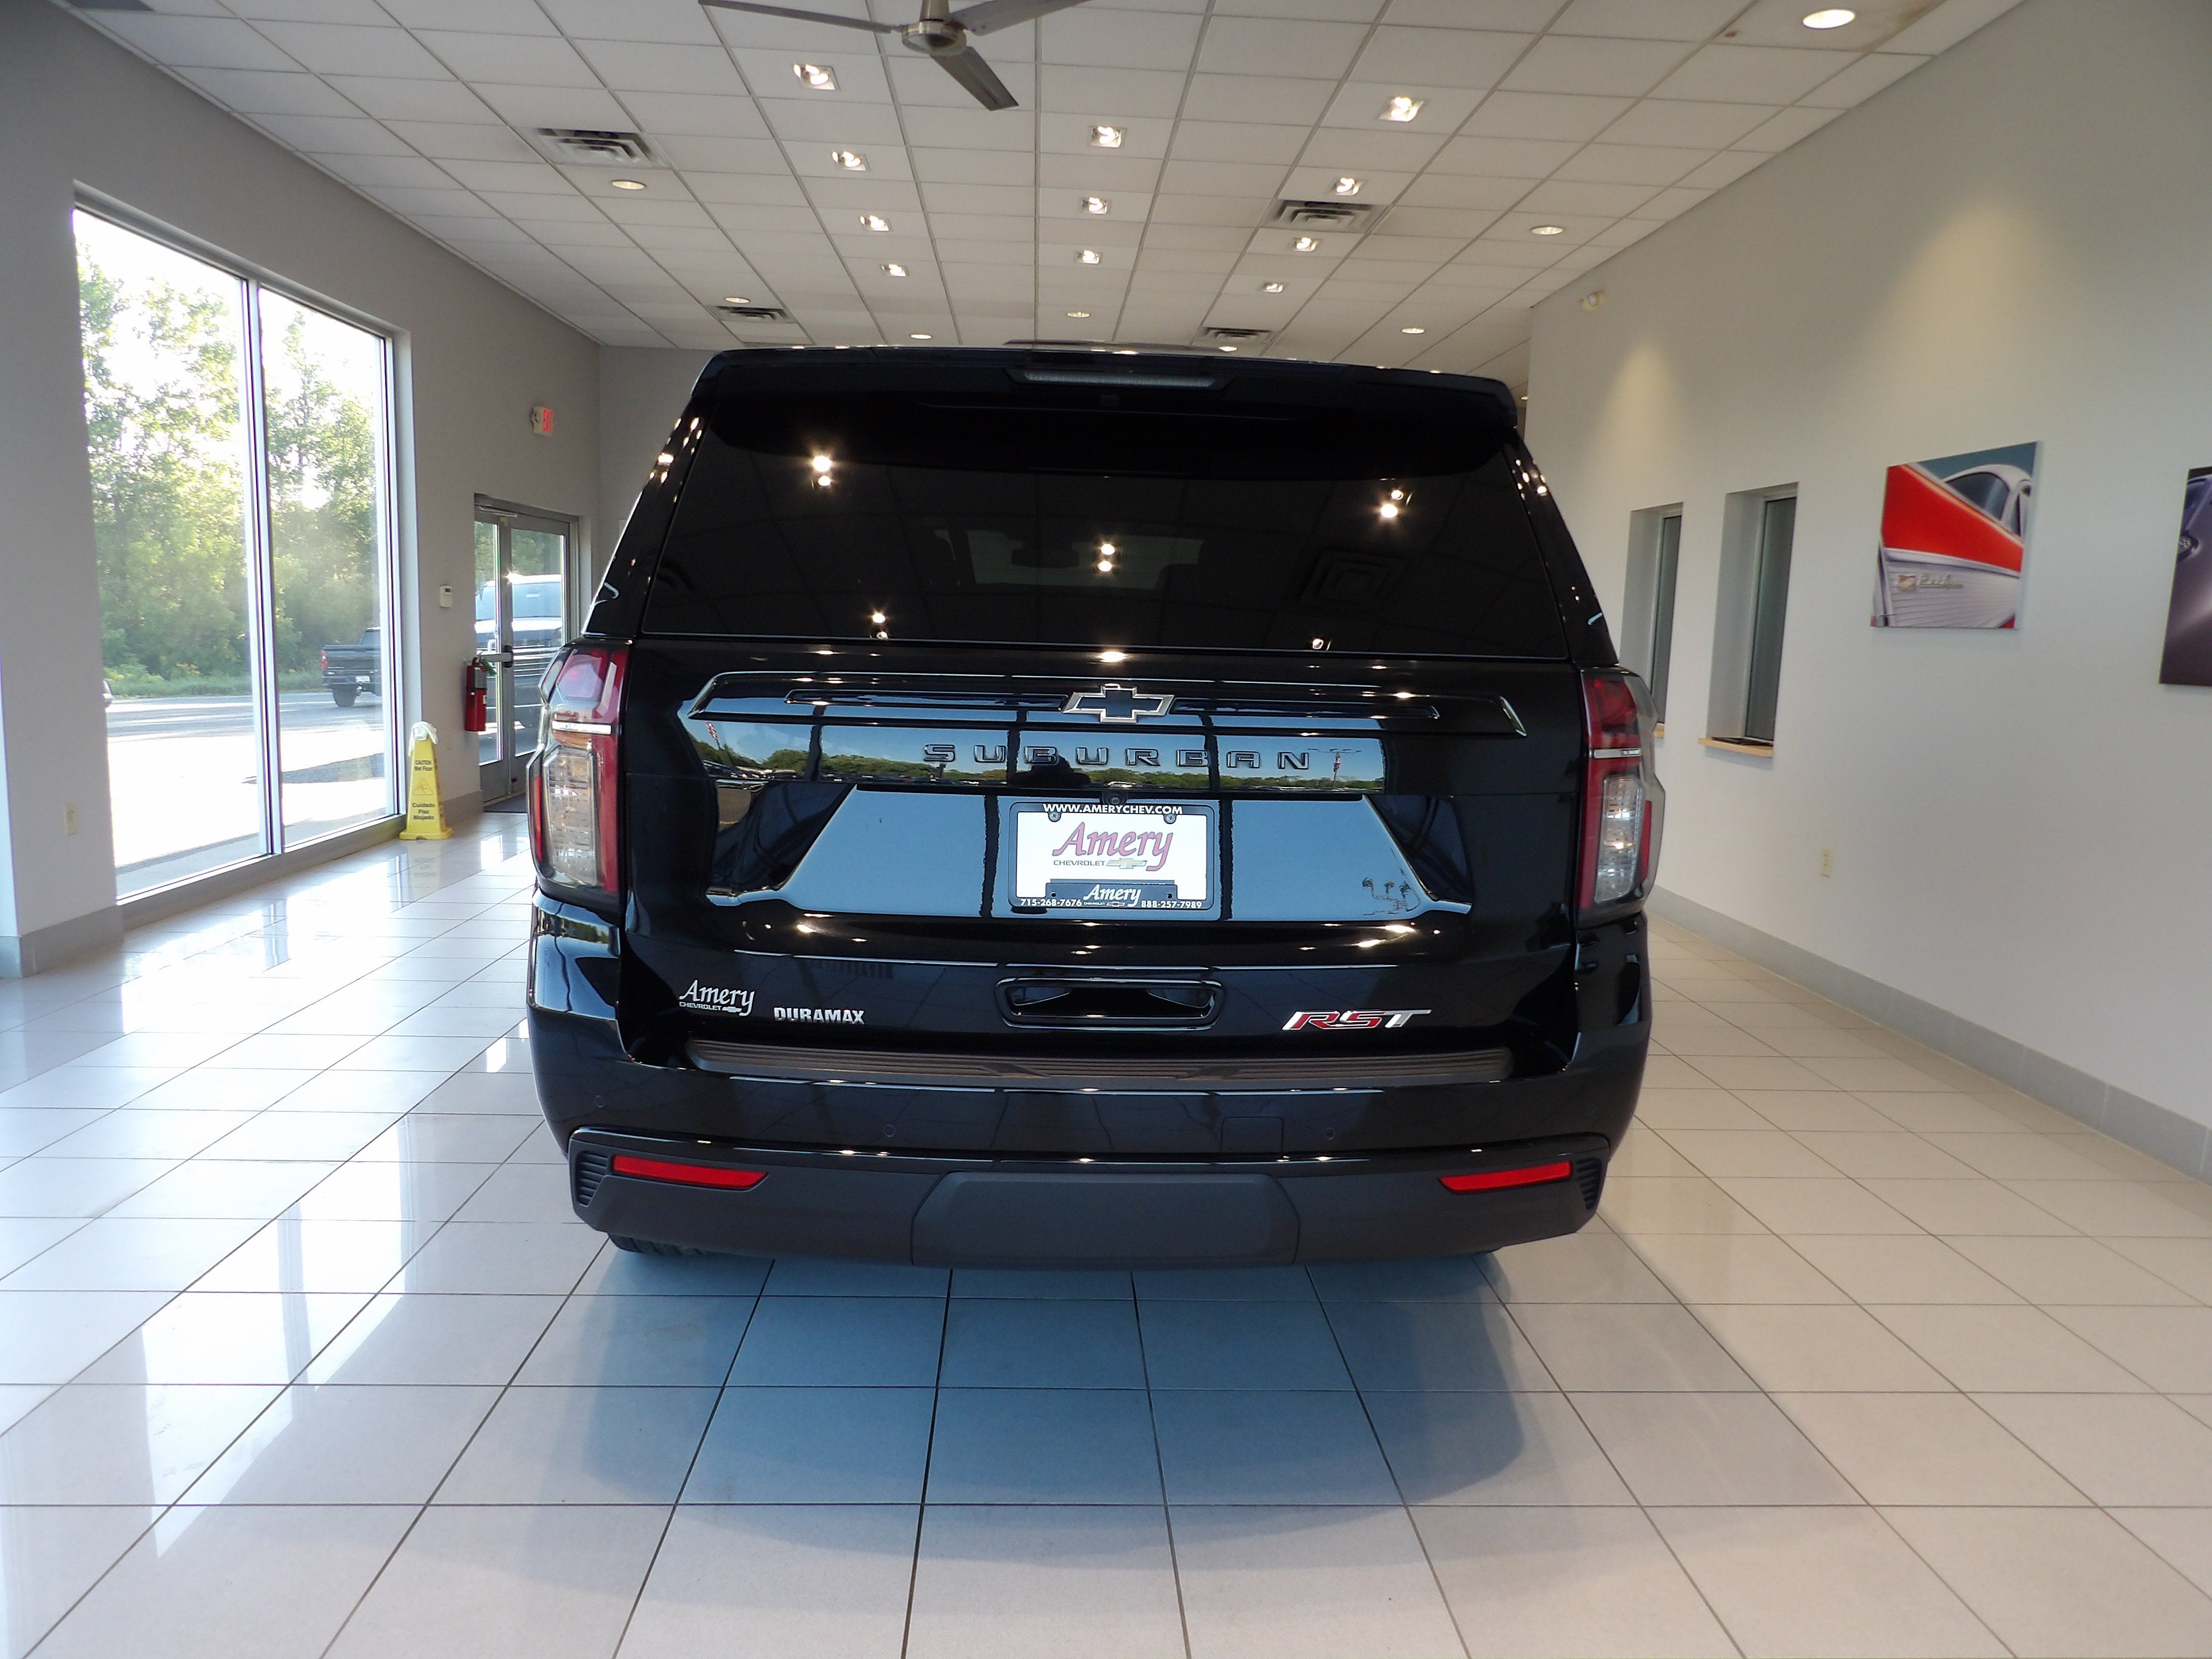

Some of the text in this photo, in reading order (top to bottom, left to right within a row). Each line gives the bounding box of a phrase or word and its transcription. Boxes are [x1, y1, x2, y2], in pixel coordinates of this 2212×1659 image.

[923, 744, 1309, 770] SUBURBAN
[1043, 803, 1183, 815] WWW.AMERYCHEV.COM
[1052, 821, 1174, 871] Amery
[1082, 884, 1142, 907] Amery
[1141, 900, 1202, 909] 888-257-7989
[679, 979, 755, 1016] Amery
[679, 1001, 722, 1010] CHEVROLET
[773, 1007, 865, 1024] DURAMAX
[1282, 1009, 1432, 1030] RST
